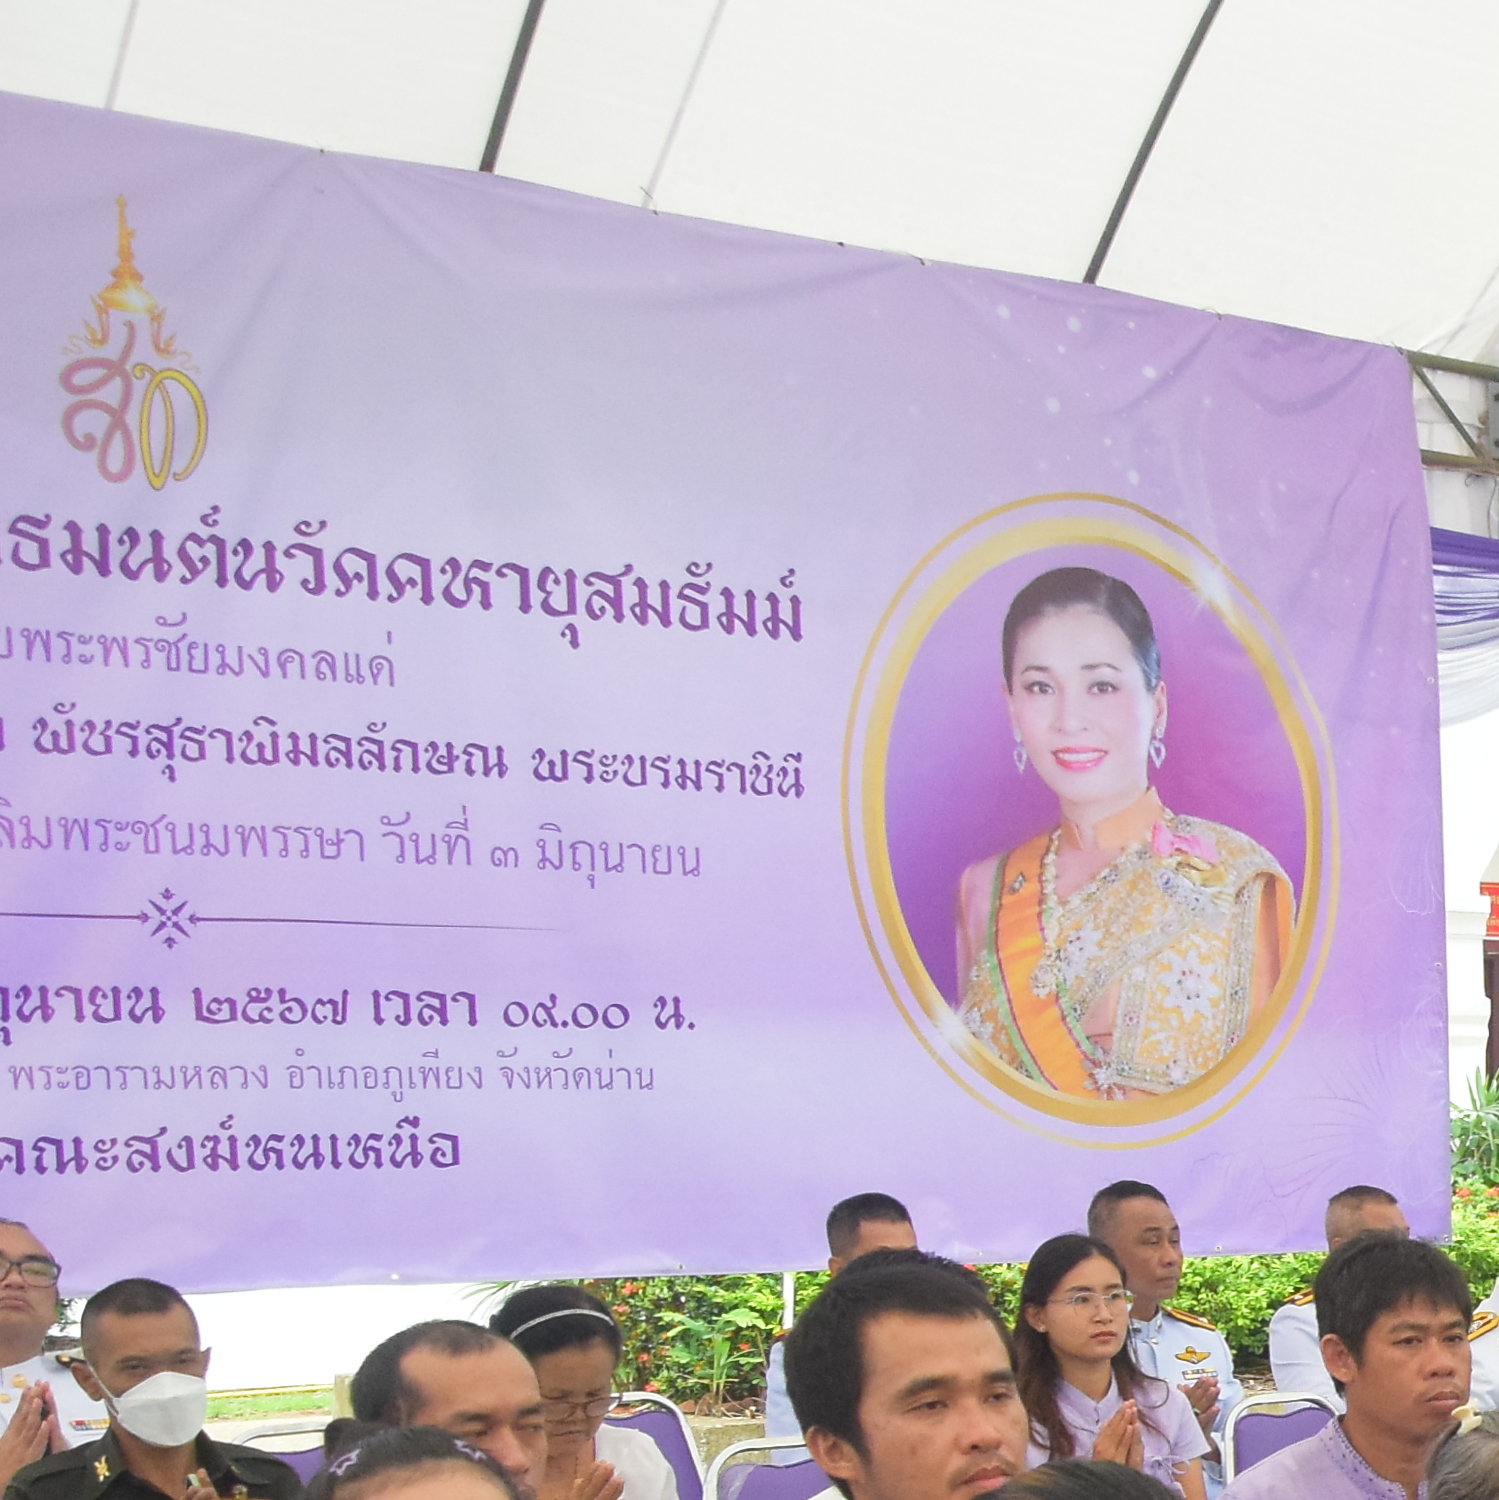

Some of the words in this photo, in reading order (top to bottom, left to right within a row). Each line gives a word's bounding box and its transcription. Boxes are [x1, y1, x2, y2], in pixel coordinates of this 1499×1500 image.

[0, 504, 804, 650] ธมนต์นวัคคหายุสมธัมม์
[32, 701, 509, 782] พัชรสุธาพิมลลักษณ
[531, 746, 805, 800] พระบรมราชินี
[380, 804, 472, 866] วันที่
[490, 846, 519, 868] ๓
[536, 822, 701, 890] มิถุนายน
[0, 984, 165, 1047] ุนายน
[191, 986, 349, 1026] ๒๕๖๗
[371, 989, 478, 1028] เวลา
[502, 993, 630, 1030] ๐๙.๐๐
[653, 995, 696, 1031] น.
[8, 1064, 269, 1090] พระอารามหลวง
[286, 1047, 483, 1103] อำเภอภูเพียง
[496, 1046, 655, 1091] จังหวัดน่าน
